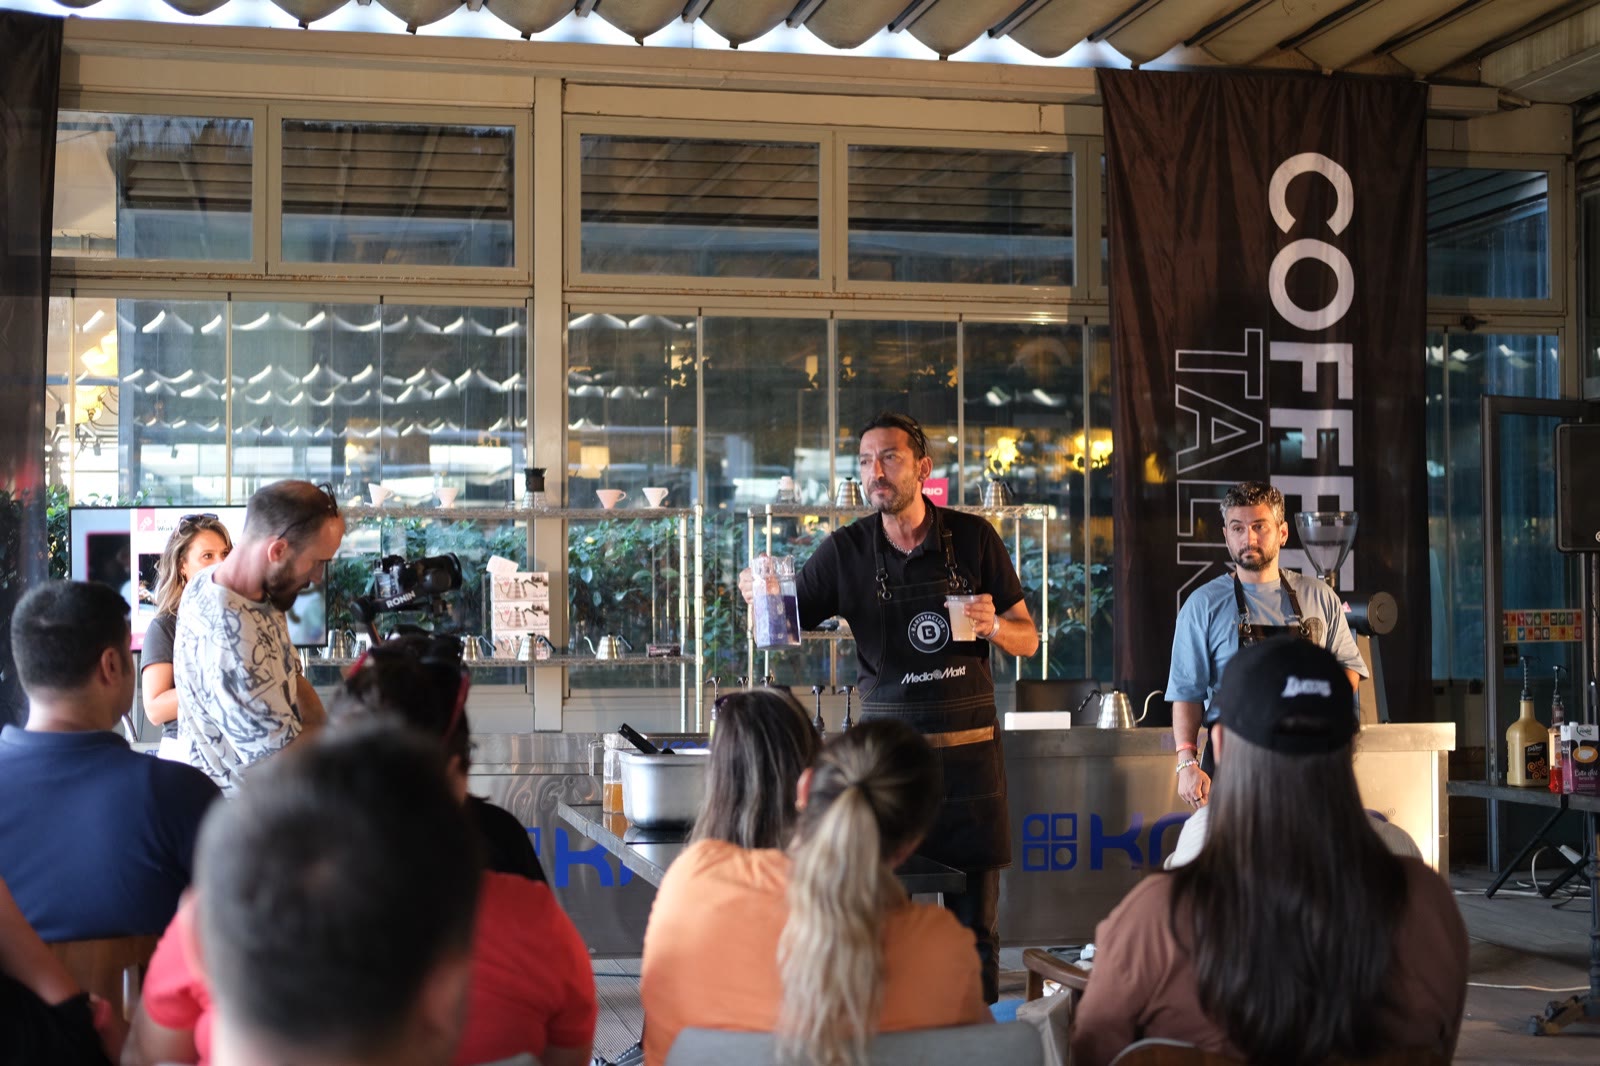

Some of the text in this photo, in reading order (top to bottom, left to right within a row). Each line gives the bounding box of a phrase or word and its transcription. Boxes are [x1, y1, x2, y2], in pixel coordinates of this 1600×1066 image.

[1268, 152, 1354, 592] COFFEE
[385, 590, 416, 608] RONIN
[911, 614, 946, 632] BARISTACLUB
